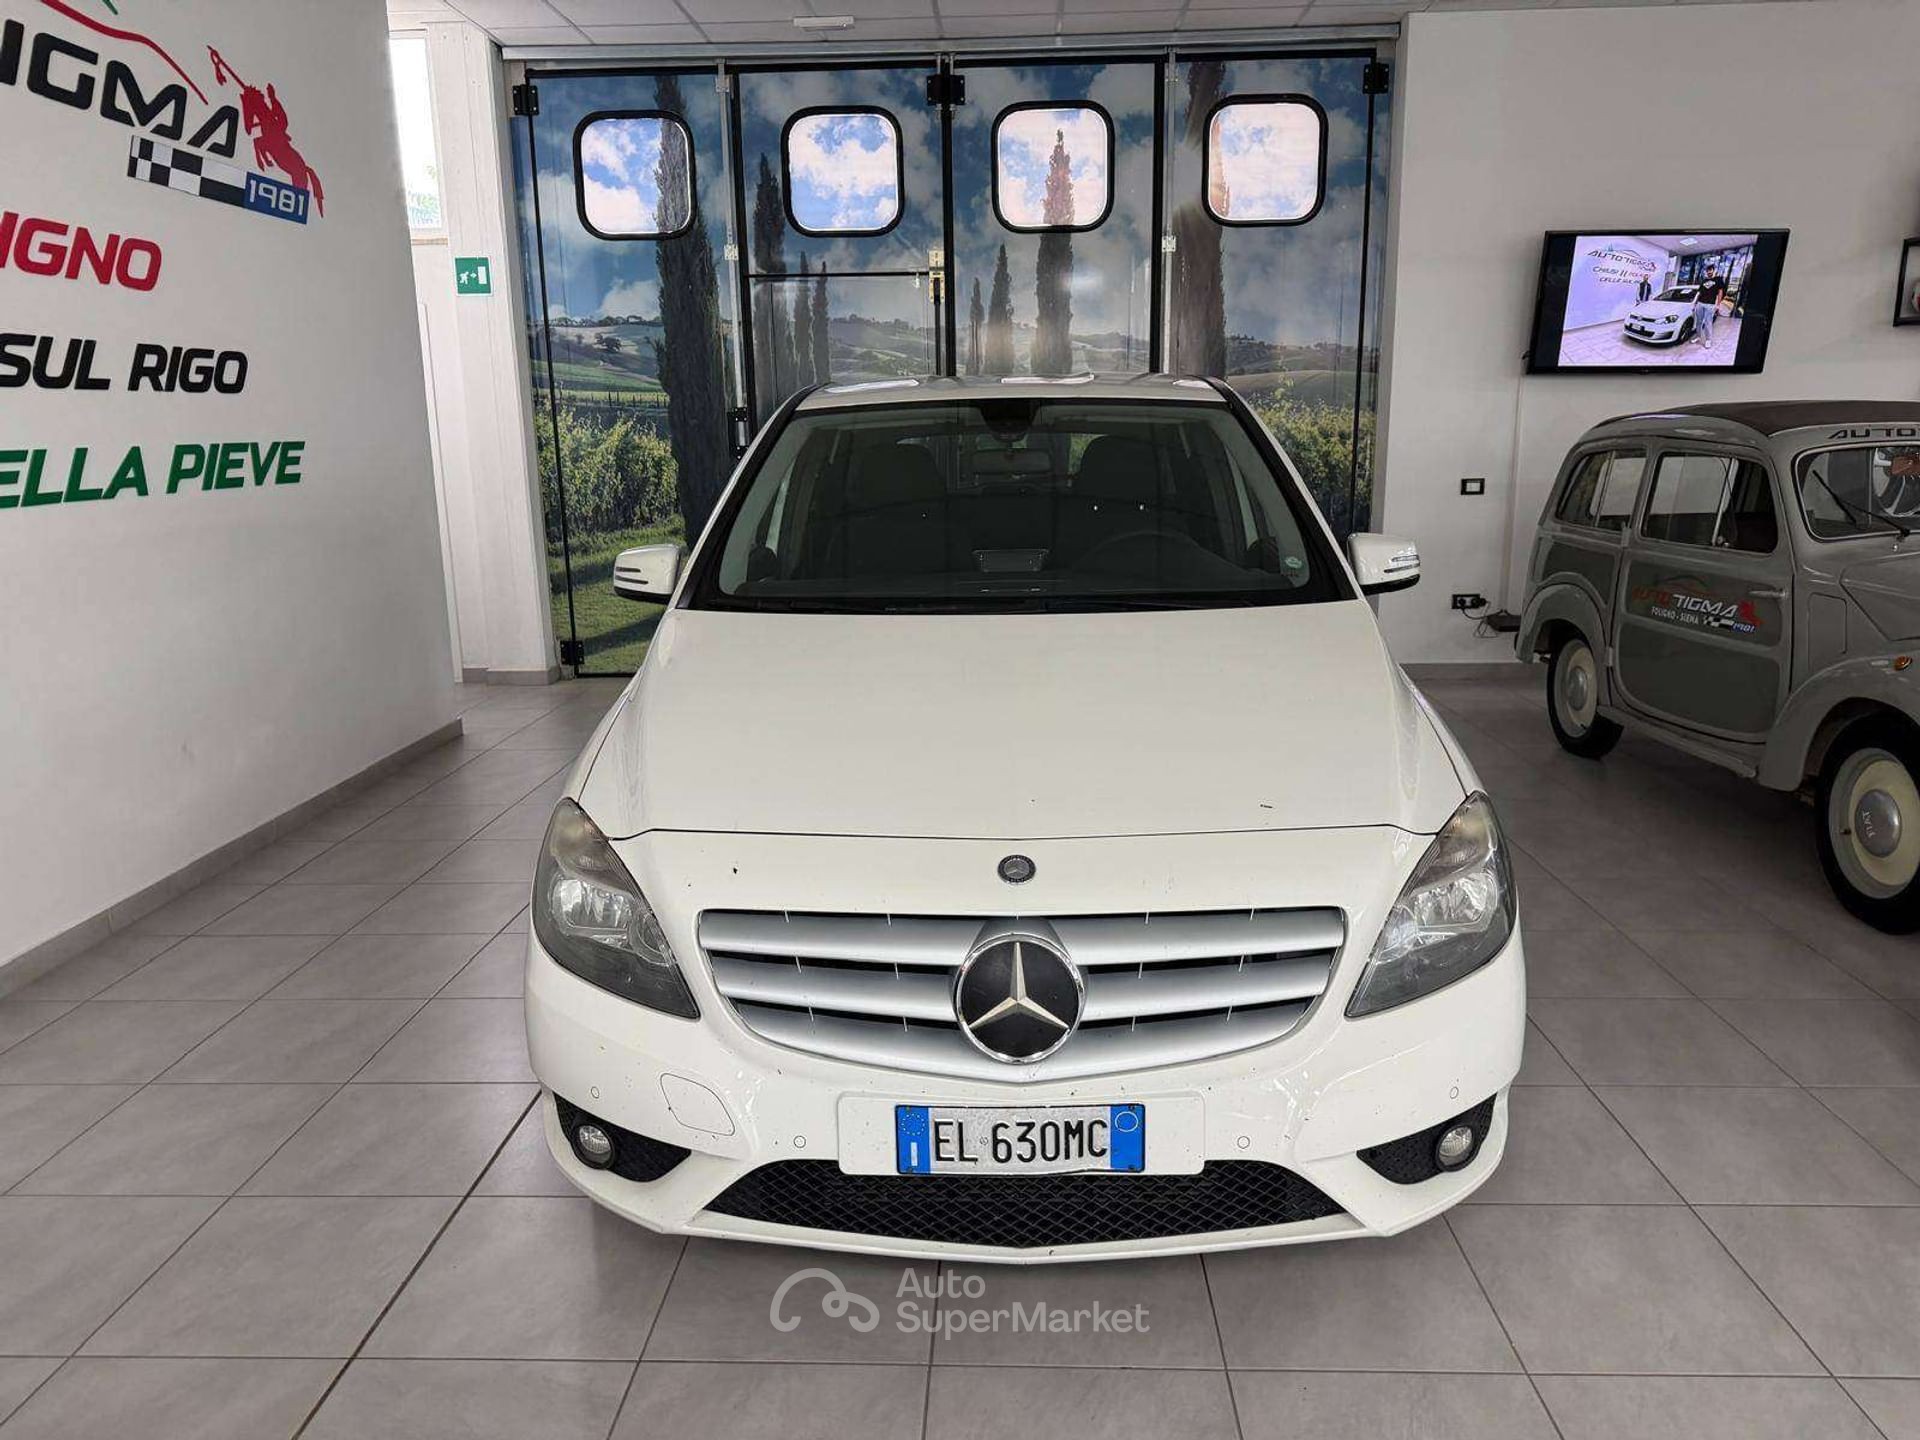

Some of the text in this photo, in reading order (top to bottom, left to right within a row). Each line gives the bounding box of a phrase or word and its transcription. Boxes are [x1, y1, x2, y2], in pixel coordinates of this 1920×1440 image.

[249, 179, 305, 216] 1981
[0, 333, 248, 394] SUL RIGO
[1828, 428, 1917, 439] AUTO
[166, 441, 305, 494] PIEVE
[1672, 593, 1738, 617] TIGMA
[934, 1120, 978, 1163] EL
[991, 1119, 1108, 1164] 630MC
